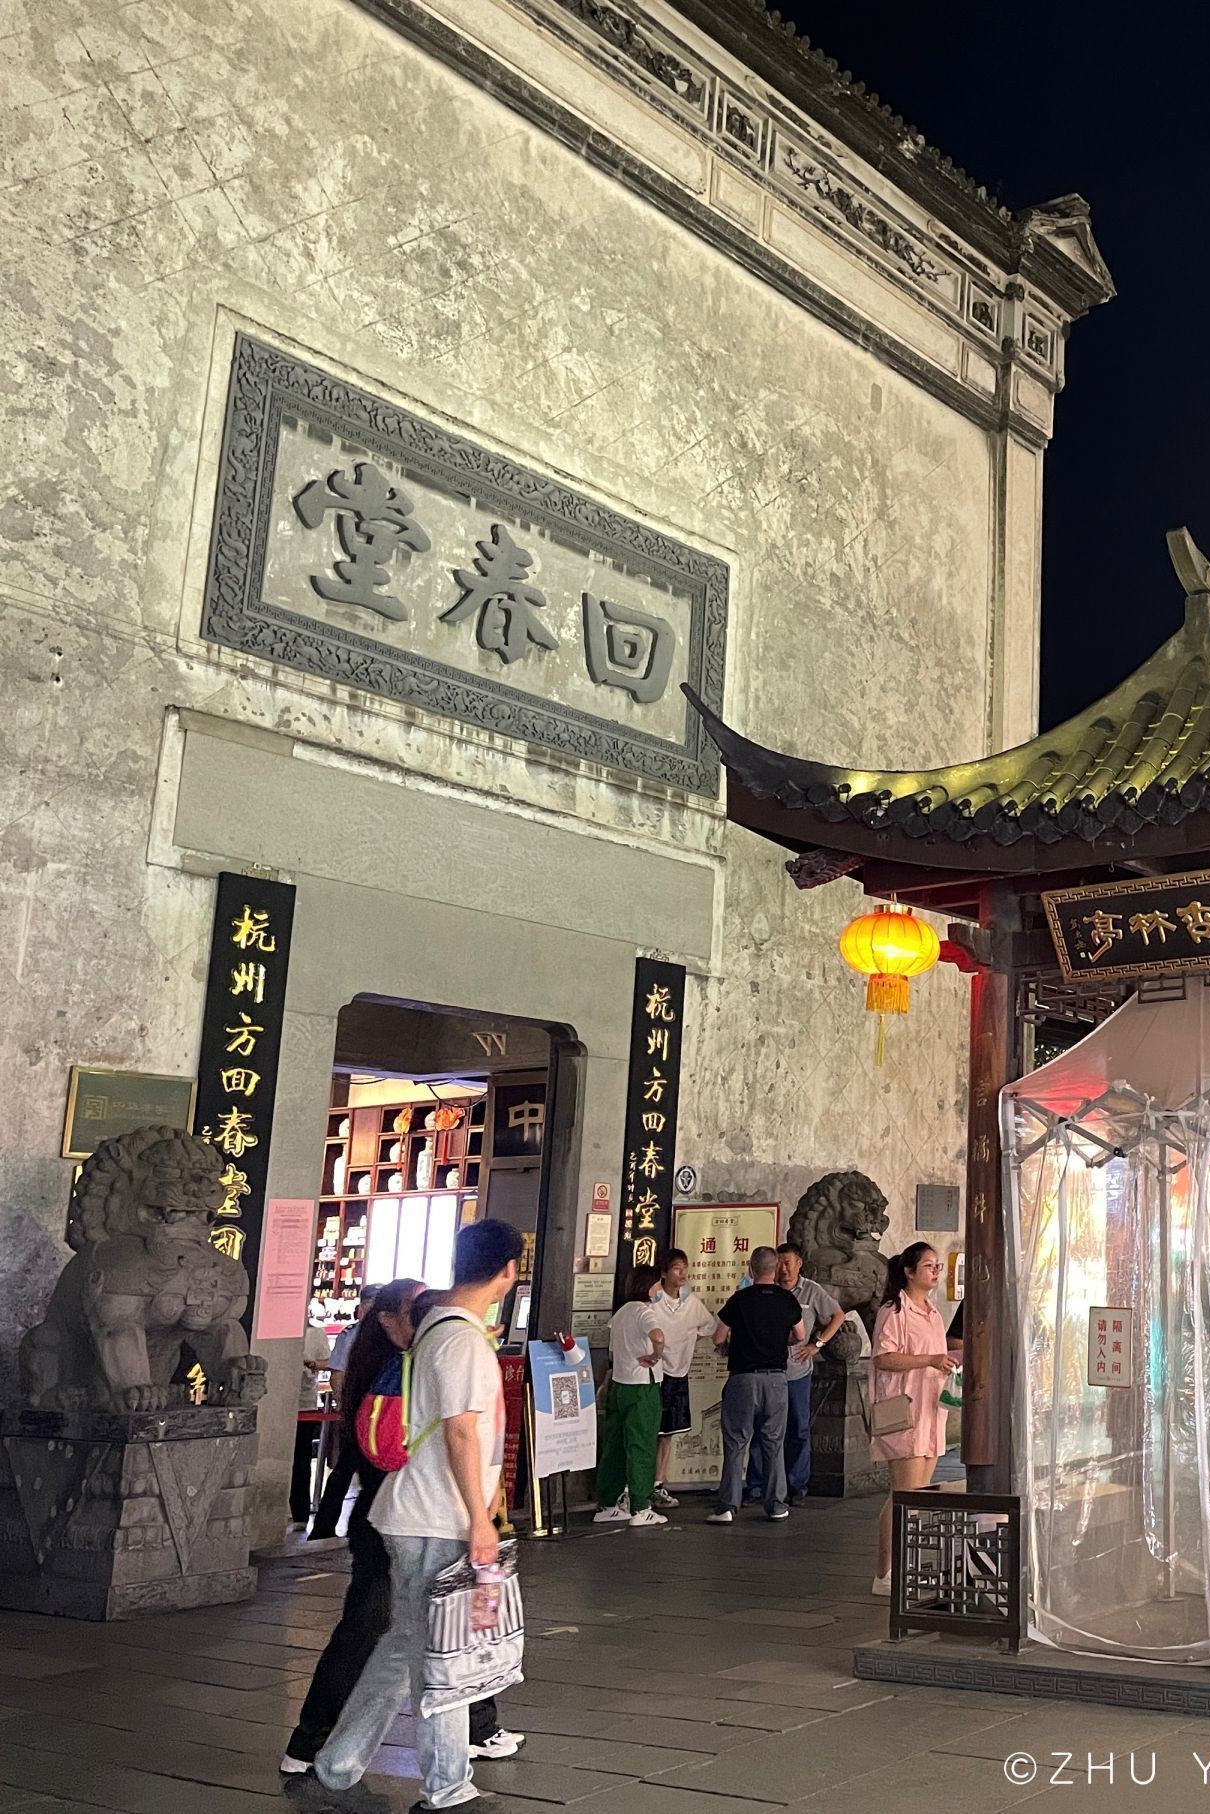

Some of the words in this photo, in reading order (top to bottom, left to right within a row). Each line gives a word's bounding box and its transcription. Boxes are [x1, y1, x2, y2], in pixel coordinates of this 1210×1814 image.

[293, 462, 676, 704] 回春堂
[700, 1236, 749, 1254] 通知
[1096, 1319, 1107, 1373] 请勿入内
